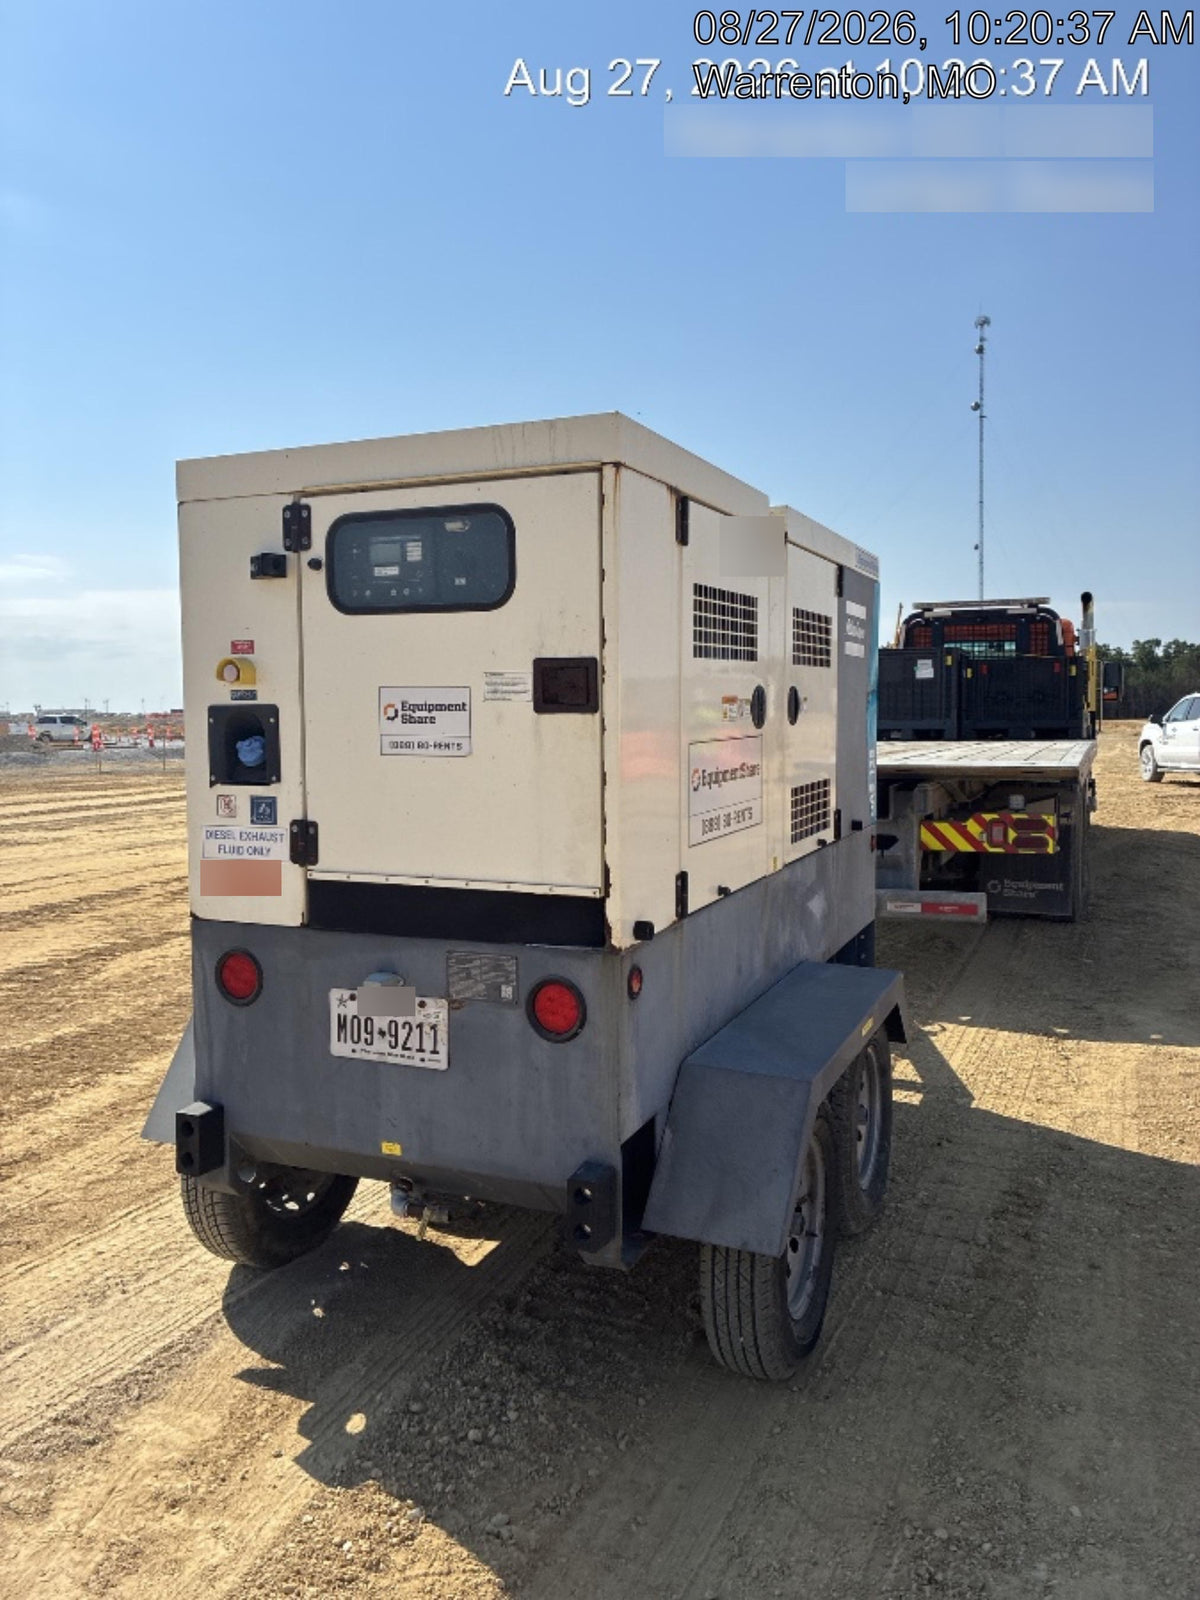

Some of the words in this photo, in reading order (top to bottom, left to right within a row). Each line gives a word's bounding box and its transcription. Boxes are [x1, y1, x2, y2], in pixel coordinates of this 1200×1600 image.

[401, 701, 467, 713] Equipment
[401, 713, 436, 725] Share
[205, 830, 236, 840] DIESEL
[239, 831, 285, 843] EXHAUST
[218, 845, 245, 855] FLUID
[247, 846, 272, 856] ONLY
